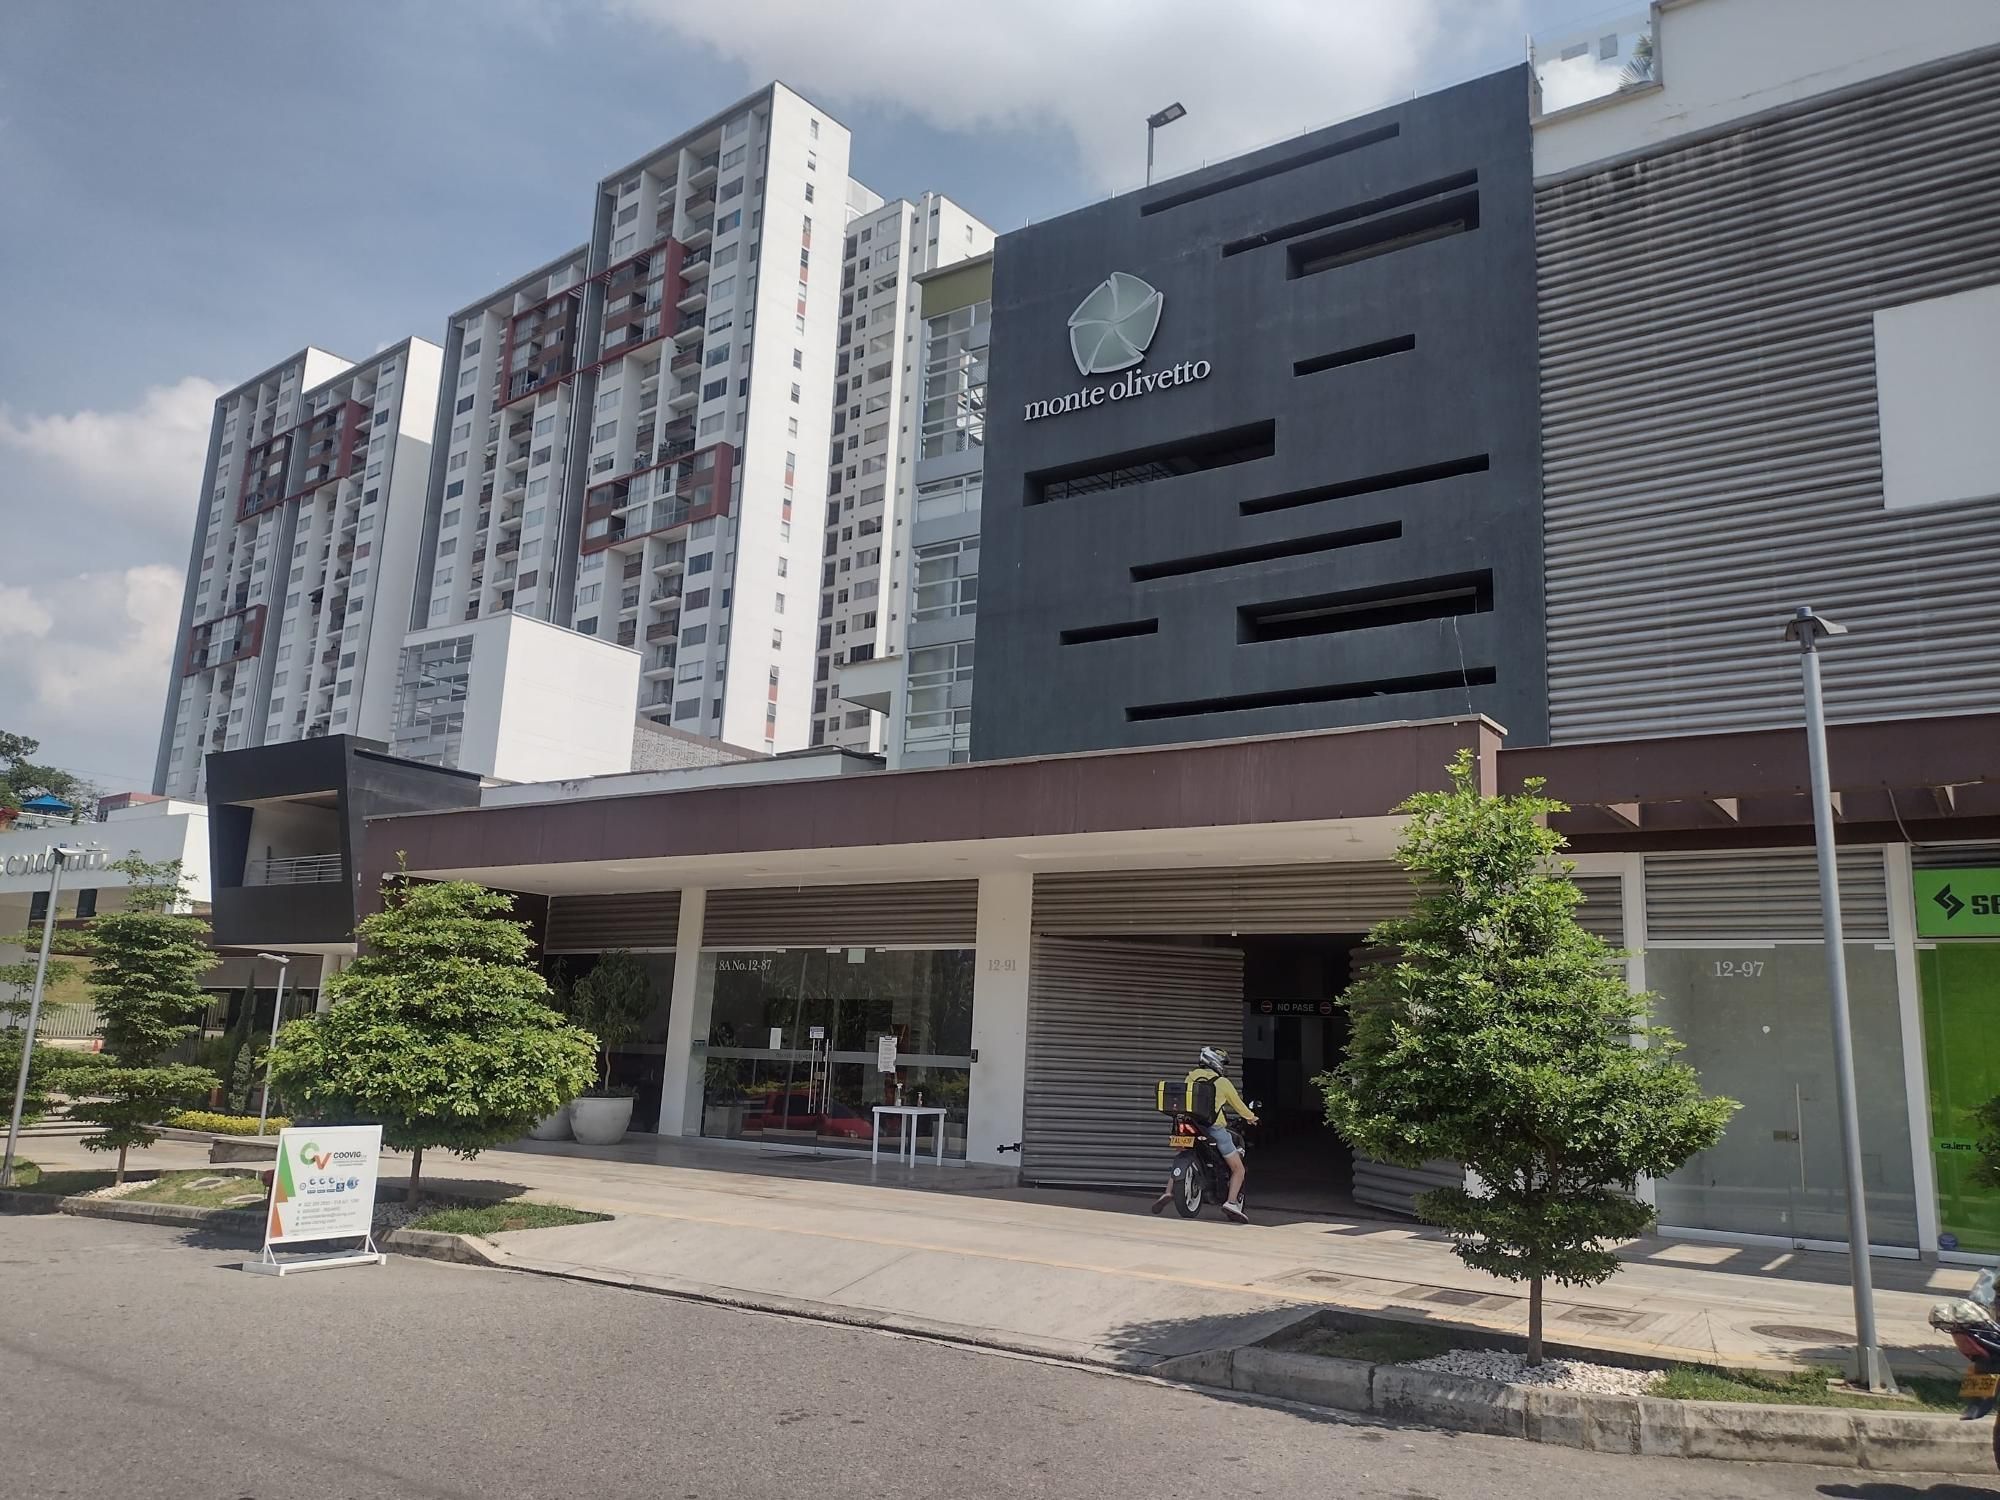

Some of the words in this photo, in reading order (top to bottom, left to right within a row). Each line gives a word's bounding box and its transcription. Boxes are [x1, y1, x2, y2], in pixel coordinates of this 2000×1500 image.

[1024, 385, 1105, 421] monte
[1109, 359, 1211, 401] olivetto
[731, 960, 747, 971] No.
[748, 959, 772, 971] 12-87
[988, 959, 1016, 971] 12-91
[1713, 960, 1764, 977] 12-97
[1277, 1003, 1290, 1012] NO
[1292, 1003, 1314, 1012] PASE
[333, 1151, 361, 1159] COOVIG
